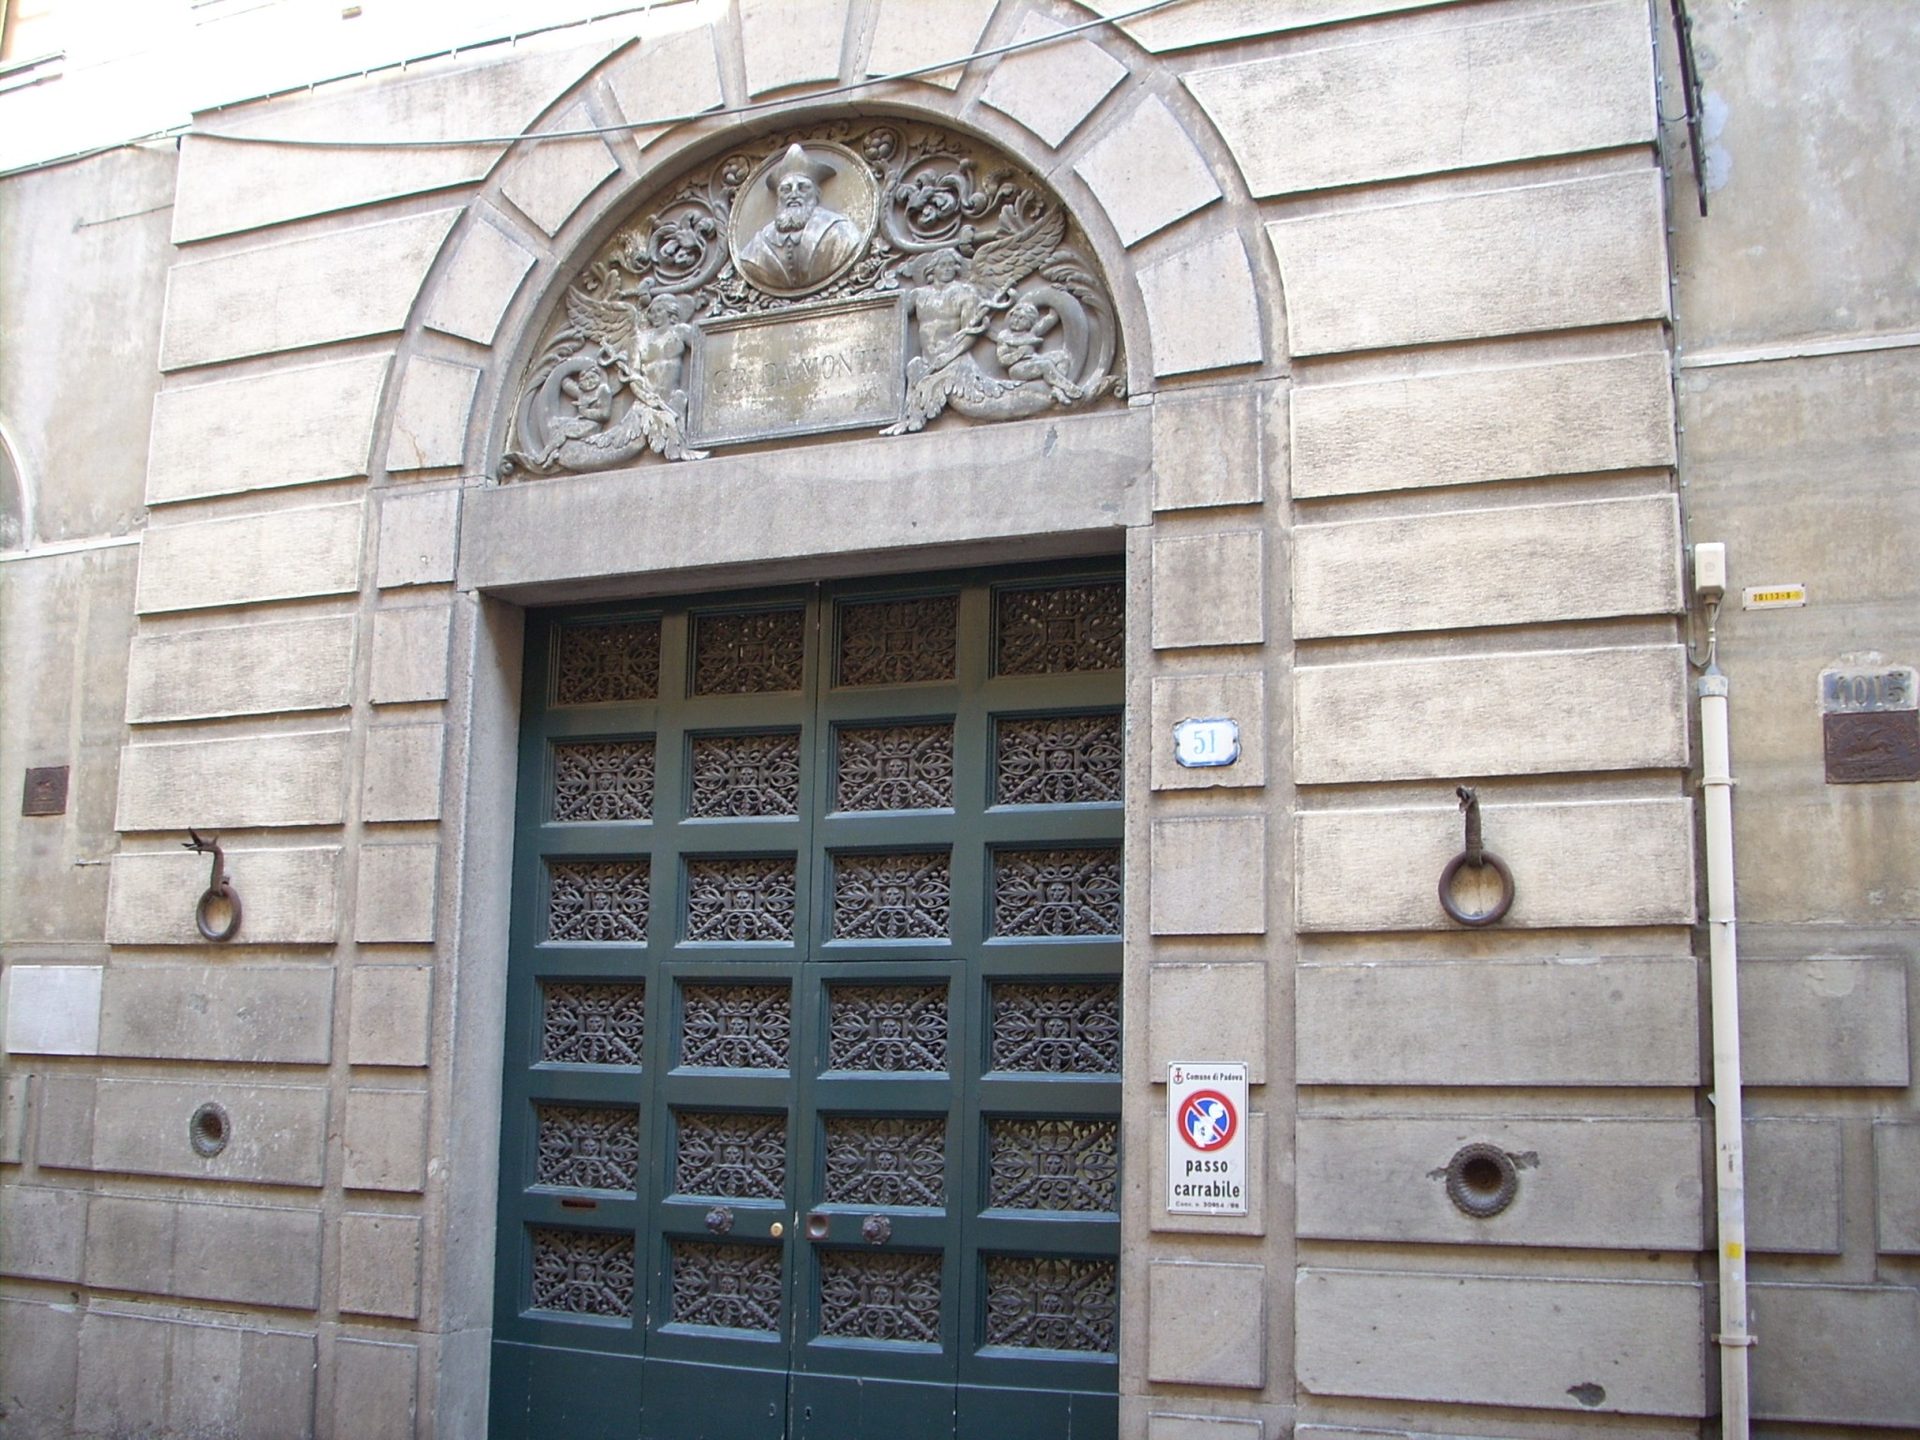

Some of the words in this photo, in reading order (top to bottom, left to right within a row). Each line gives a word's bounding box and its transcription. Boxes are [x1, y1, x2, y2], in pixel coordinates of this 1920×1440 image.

[1193, 730, 1215, 754] 51
[1186, 1072, 1211, 1081] Comune
[1212, 1072, 1219, 1081] di
[1220, 1073, 1243, 1081] Padova
[1186, 1160, 1228, 1176] passo
[1174, 1180, 1240, 1198] carrabile
